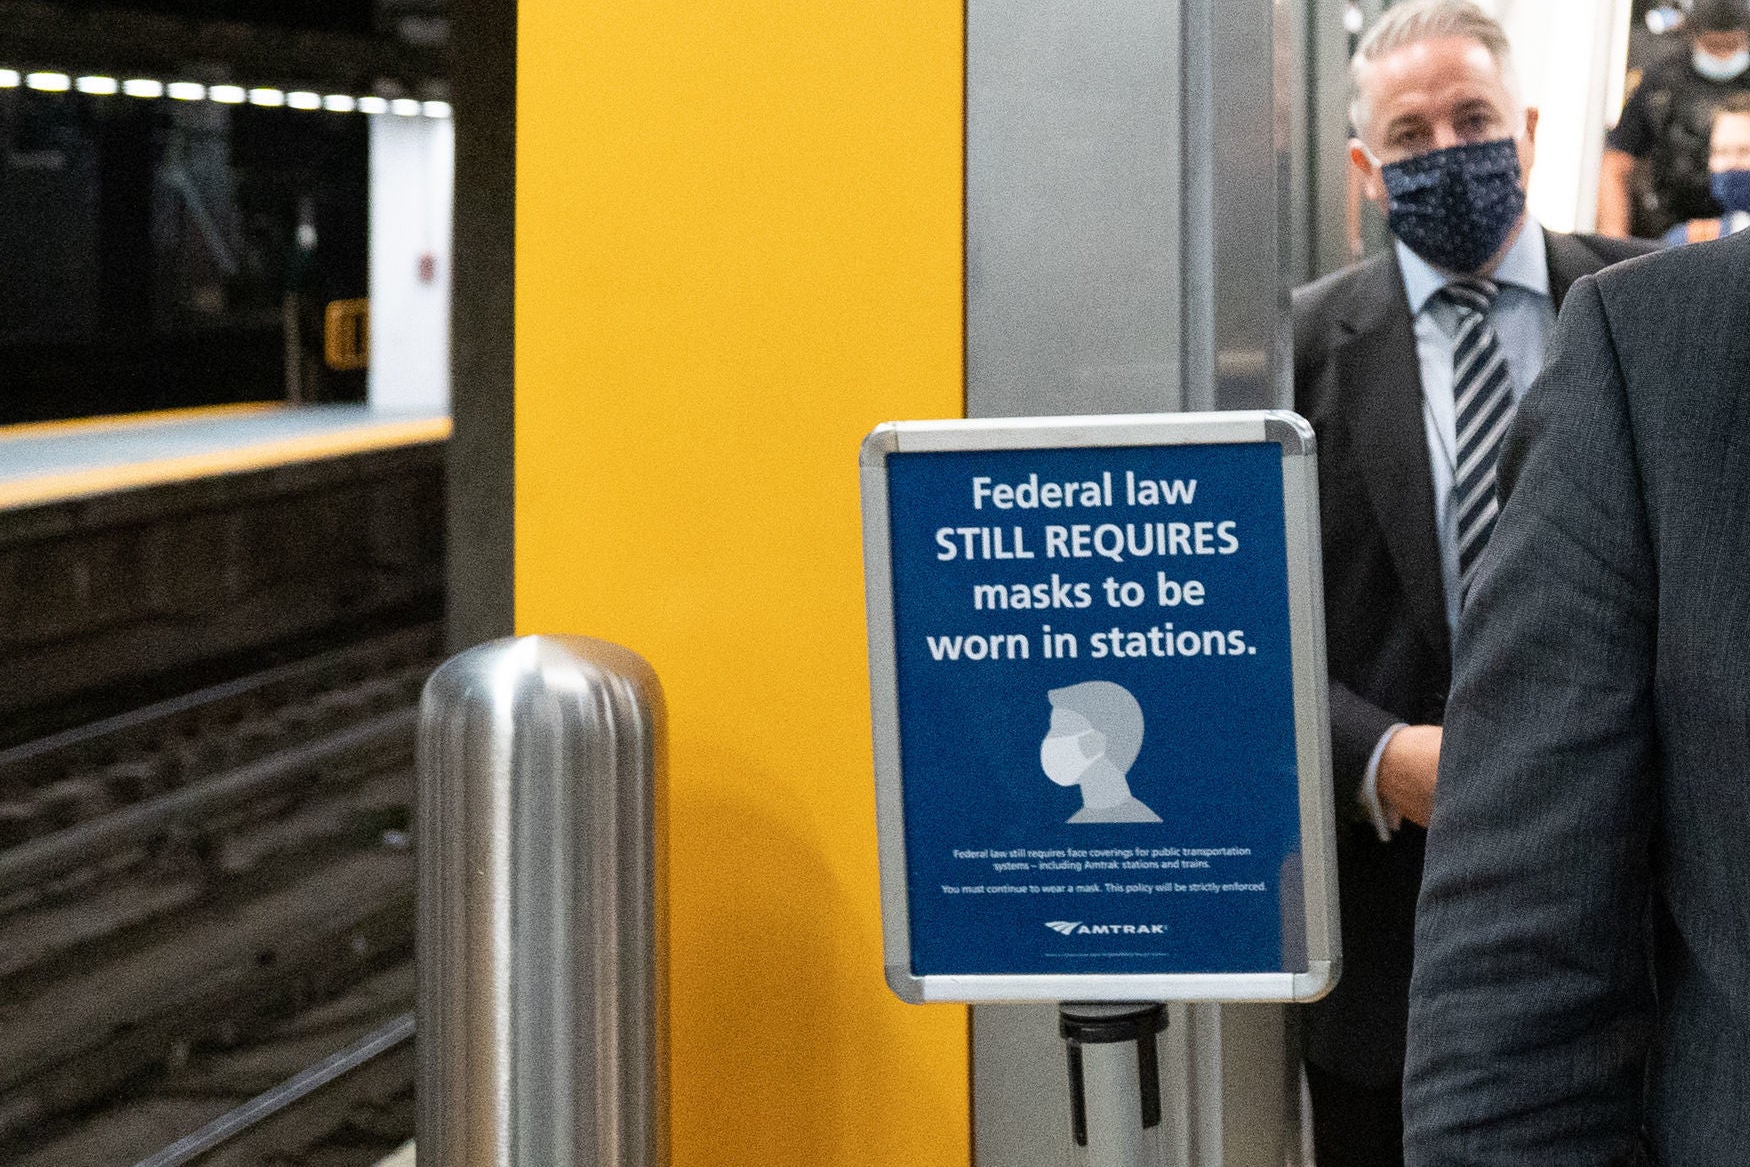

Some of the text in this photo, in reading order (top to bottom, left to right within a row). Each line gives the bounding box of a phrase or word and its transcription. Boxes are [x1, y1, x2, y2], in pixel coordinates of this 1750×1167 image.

[974, 470, 1197, 509] Federal law
[936, 521, 1239, 561] STILL REQUIRES
[974, 571, 1205, 610] masks to be
[927, 624, 1257, 661] worn in stations.
[953, 847, 1251, 859] Federal law still requires face coverings for public transportation
[993, 861, 1029, 871] systems
[1039, 861, 1082, 872] including
[1084, 860, 1119, 869] Amtrak
[1122, 860, 1159, 869] stations
[1161, 860, 1180, 868] and
[1181, 860, 1211, 868] trains.
[941, 885, 960, 894] You
[962, 885, 985, 894] must
[986, 884, 1027, 893] continue
[1029, 885, 1040, 893] to
[1042, 885, 1065, 893] wear
[1075, 884, 1102, 892] mask.
[1105, 883, 1124, 892] This
[1125, 883, 1153, 894] policy
[1155, 882, 1173, 892] will
[1174, 882, 1187, 891] be
[1189, 882, 1220, 893] strictly
[1222, 882, 1267, 891] enforced.
